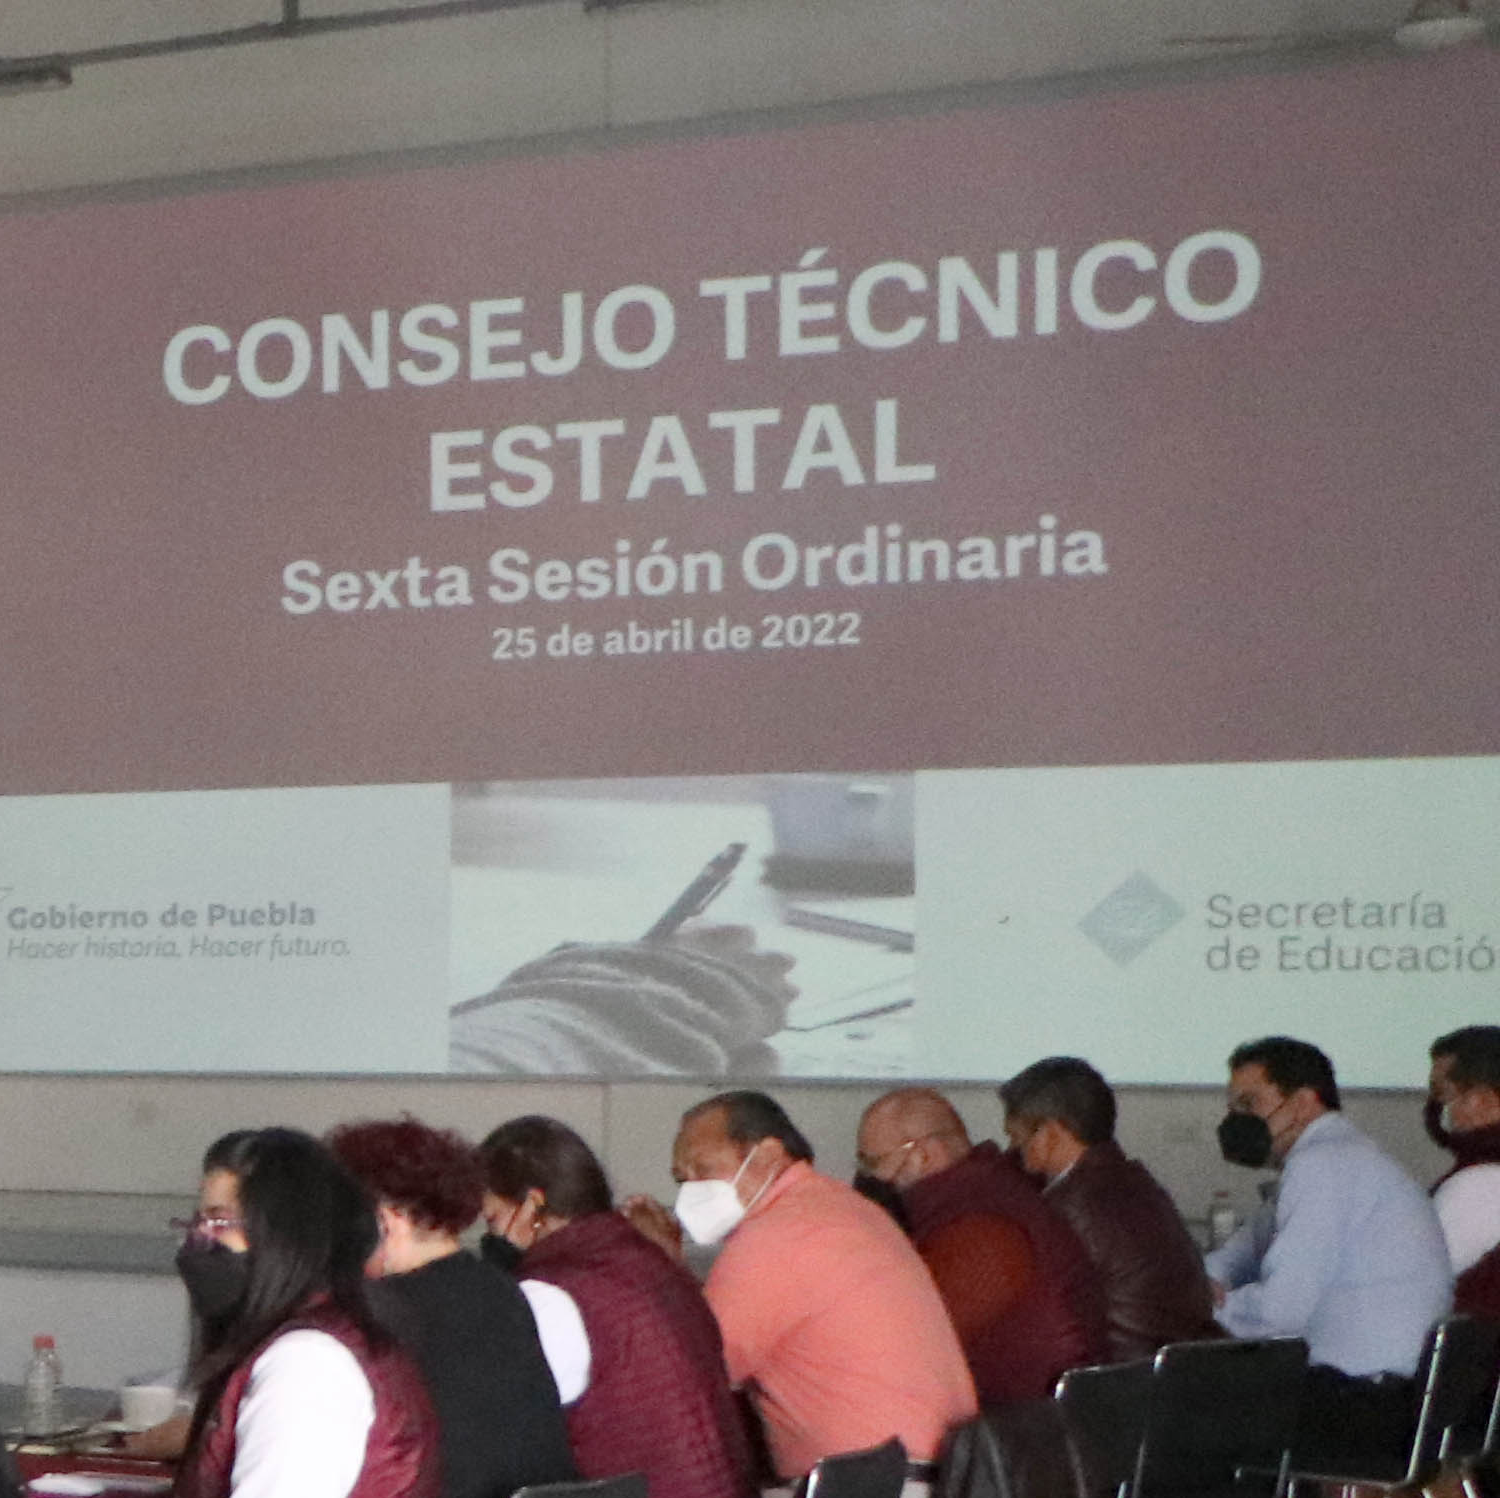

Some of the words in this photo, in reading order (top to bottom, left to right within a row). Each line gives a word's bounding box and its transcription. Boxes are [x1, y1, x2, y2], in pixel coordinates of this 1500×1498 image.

[163, 283, 676, 406] CONSEJO
[700, 230, 1263, 361] TÉCNICO
[429, 398, 937, 512] ESTATAL
[281, 555, 474, 615] Sexta
[488, 537, 723, 604] Sesión
[742, 514, 1108, 592] Ordinaria
[492, 627, 538, 660] 25
[546, 623, 593, 658] de
[603, 618, 694, 656] abril
[702, 615, 752, 651] de
[762, 612, 860, 649] 2022
[7, 904, 148, 930] Gobierno
[159, 902, 198, 928] de
[207, 901, 316, 928] Puebla
[1206, 892, 1448, 930] Secretaría
[6, 938, 79, 960] Hacer
[84, 935, 180, 959] historia.
[189, 935, 266, 958] Hacer
[268, 933, 351, 961] futuro.
[1206, 936, 1261, 972] de
[1278, 935, 1500, 974] Educació
